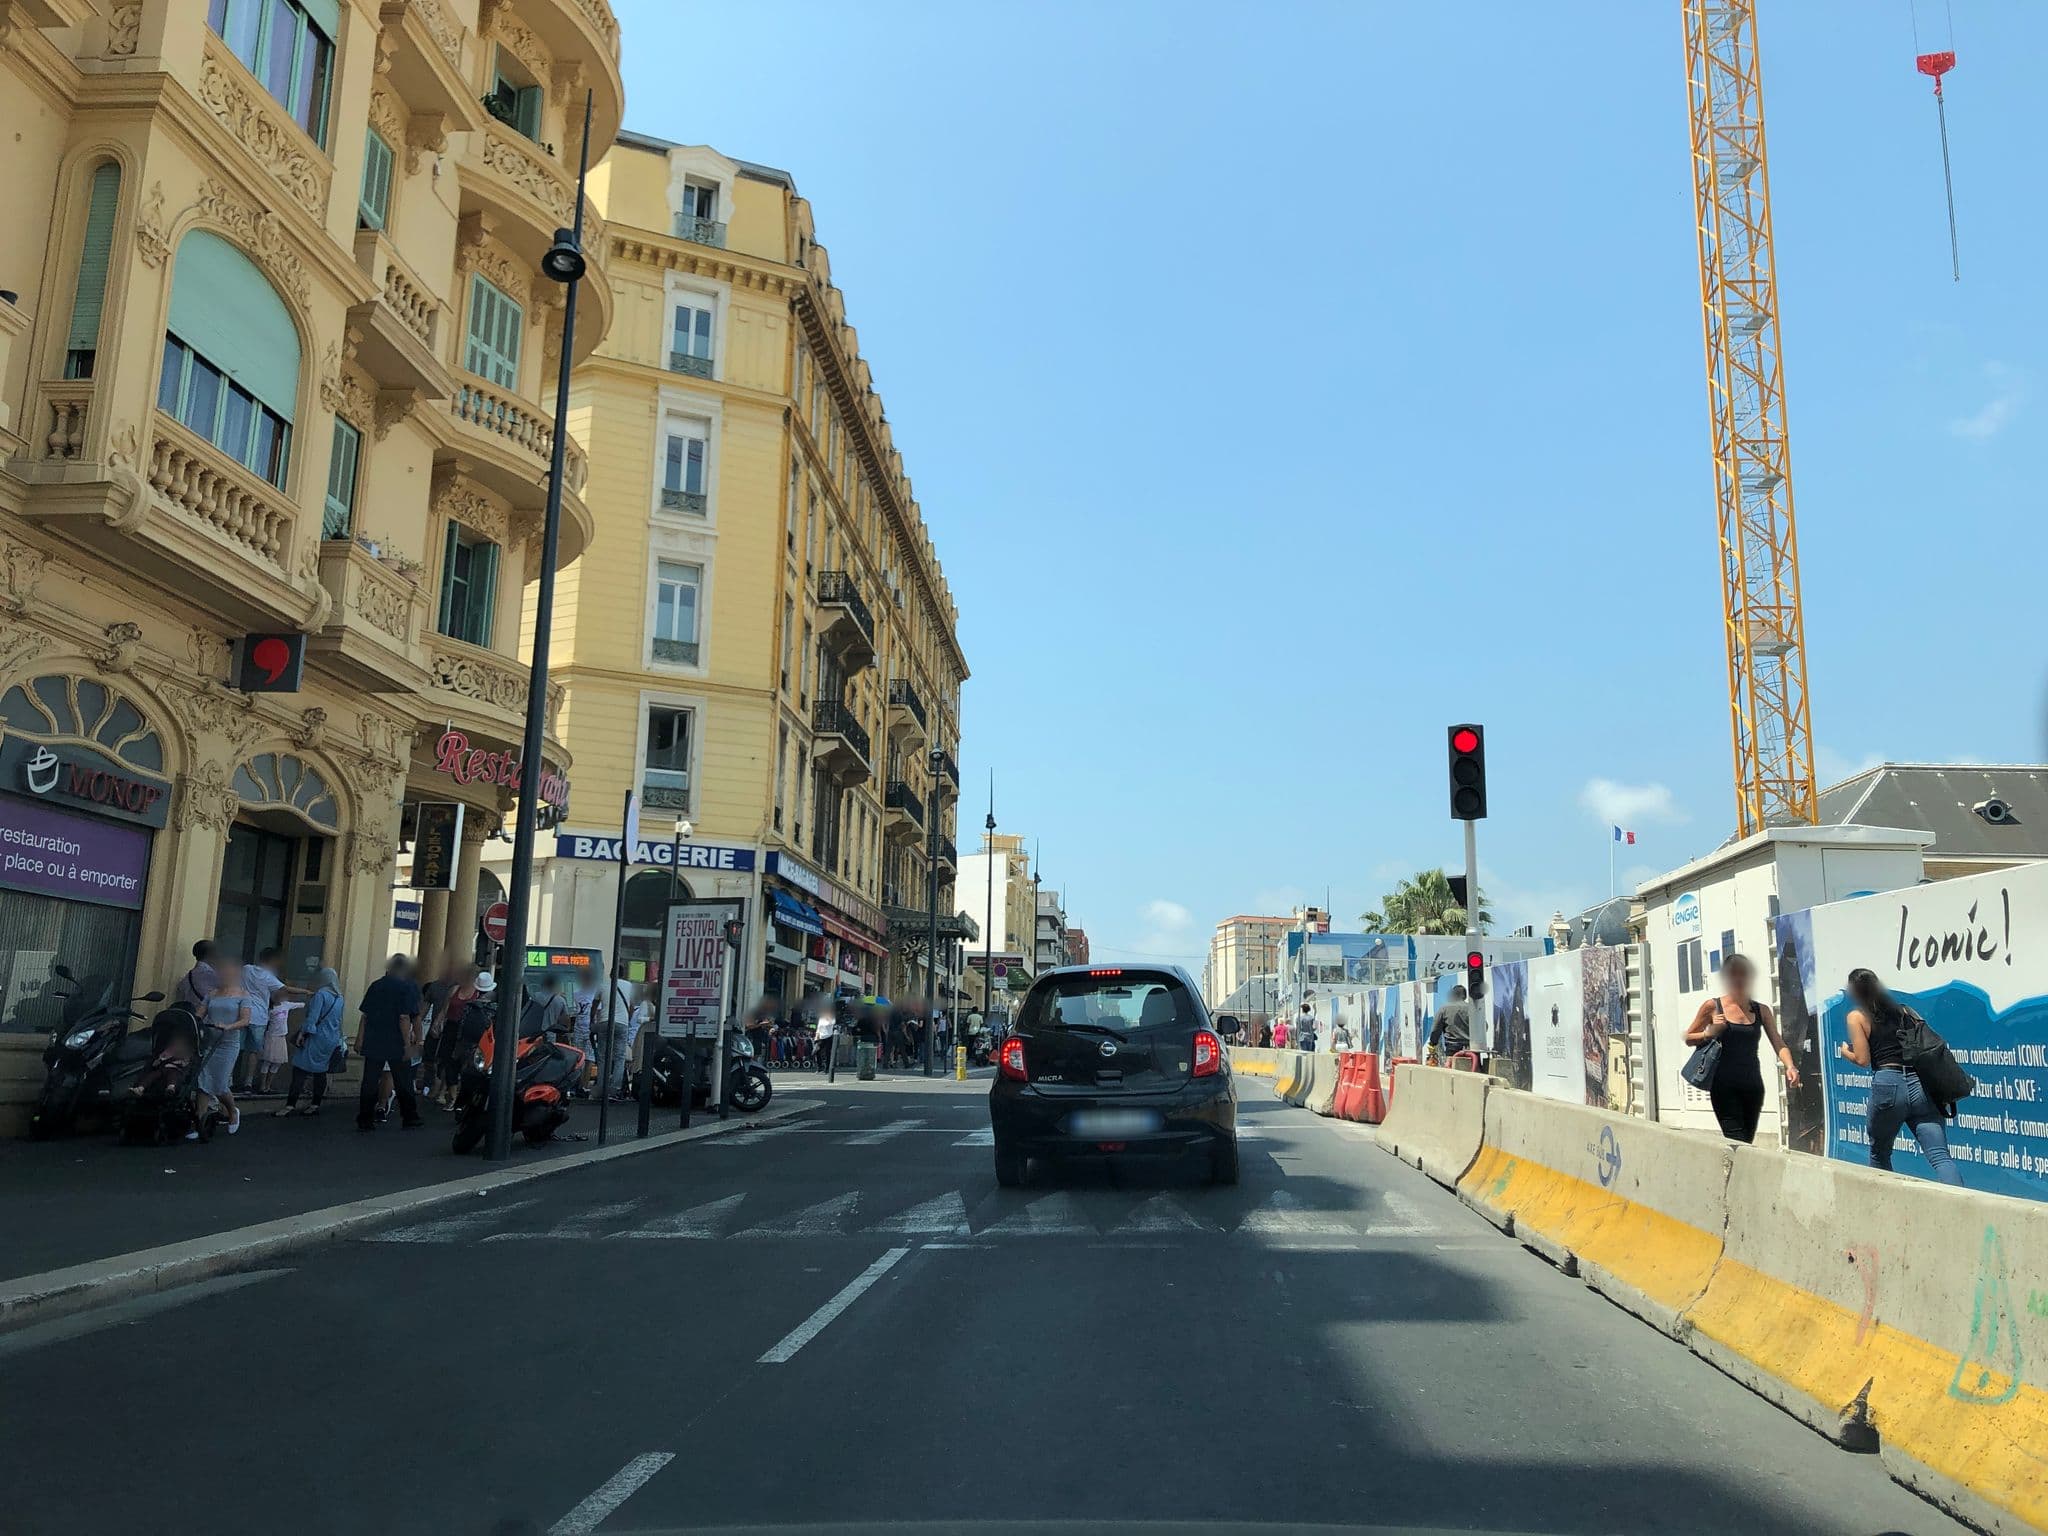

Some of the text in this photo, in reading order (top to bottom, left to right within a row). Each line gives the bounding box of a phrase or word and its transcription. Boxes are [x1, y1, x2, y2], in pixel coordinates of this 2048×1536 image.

[4, 853, 138, 890] place ou à emporter
[675, 919, 720, 937] FESTIVAL
[675, 938, 725, 969] LIVRE
[703, 970, 721, 988] NIC
[1970, 1045, 2017, 1067] construisent
[2018, 1044, 2048, 1069] ICONIC
[1037, 1074, 1064, 1082] MICRA
[1994, 1080, 2002, 1099] et
[2003, 1076, 2013, 1100] la
[2015, 1078, 2036, 1103] SNCF
[1957, 1113, 2002, 1135] comprenant
[2003, 1110, 2019, 1135] des
[1974, 1145, 1982, 1160] et
[1983, 1149, 1999, 1167] une
[2000, 1144, 2020, 1170] salle
[2021, 1146, 2034, 1172] de
